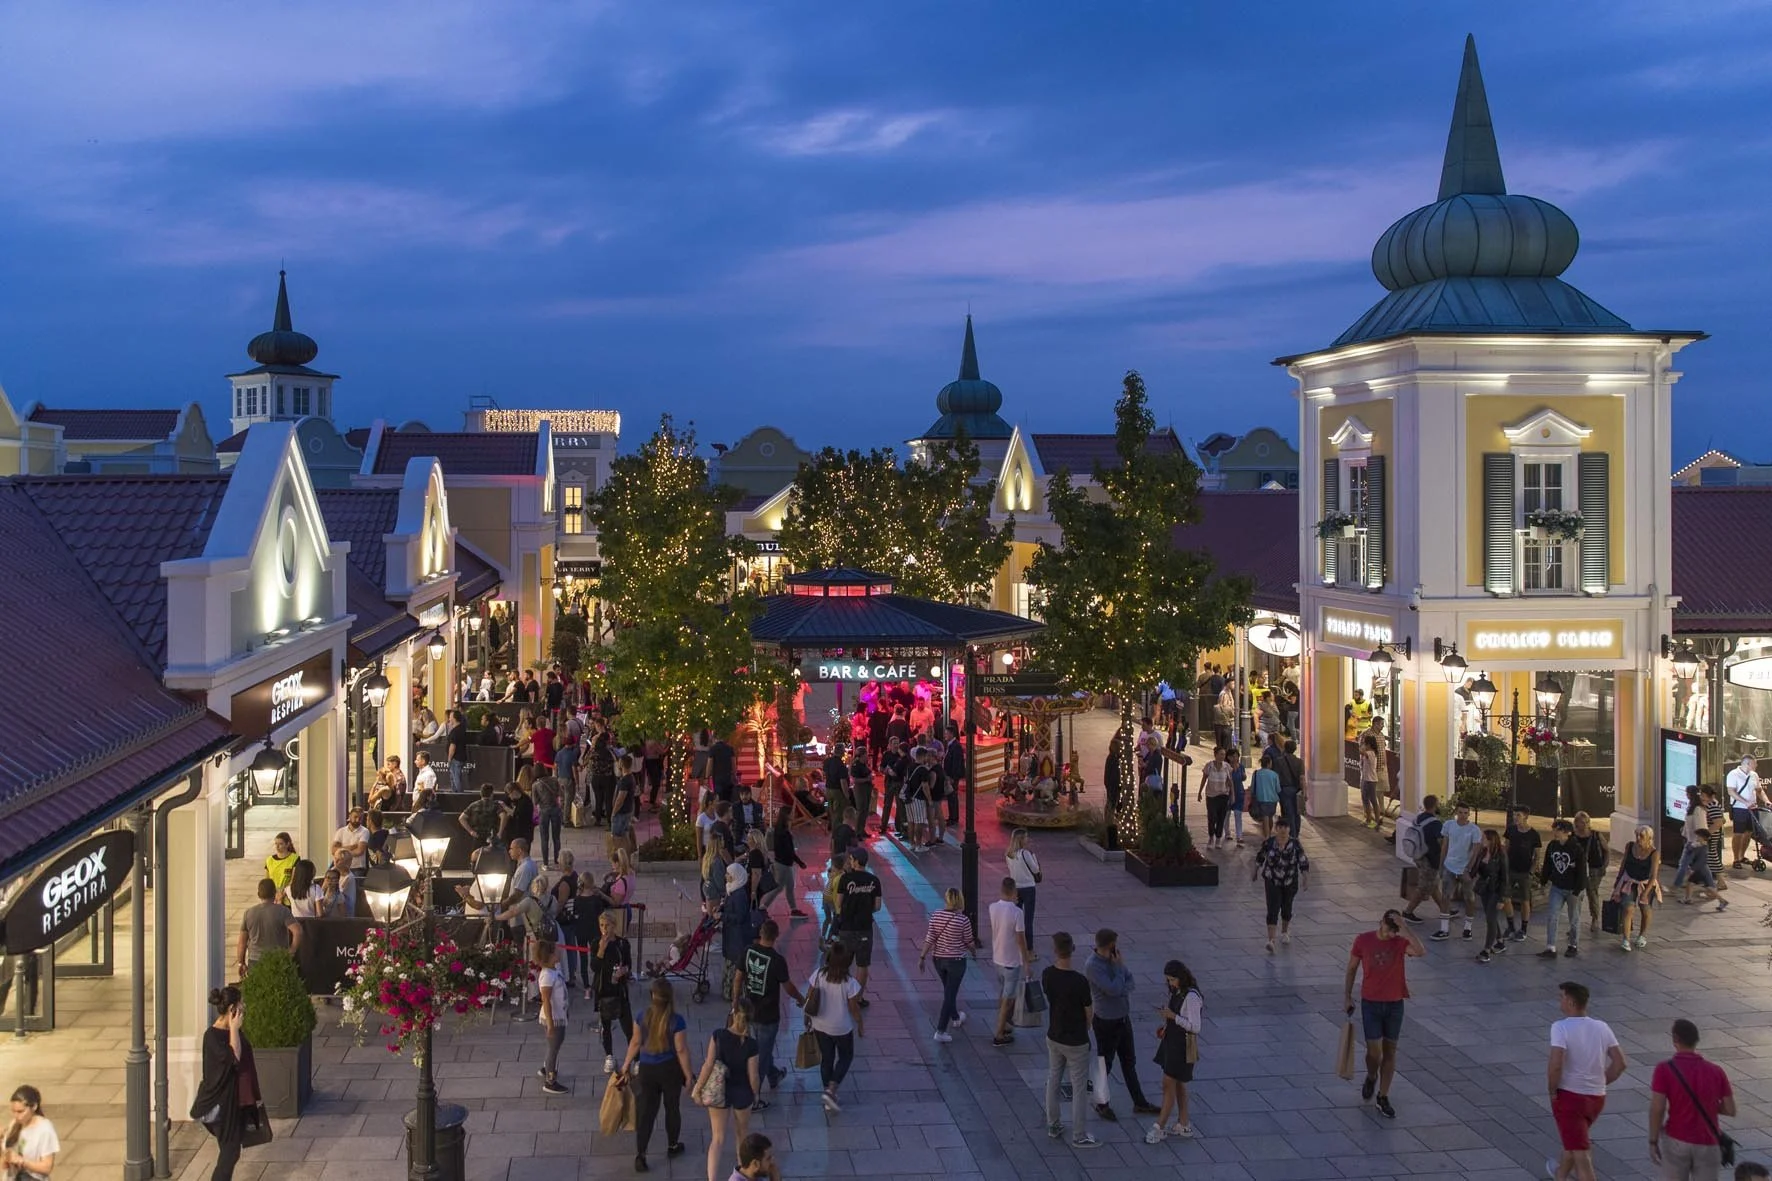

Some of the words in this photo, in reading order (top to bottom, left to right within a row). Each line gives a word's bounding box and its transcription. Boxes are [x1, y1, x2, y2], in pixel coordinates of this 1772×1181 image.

[555, 437, 588, 446] RRY
[819, 665, 852, 679] BAR
[857, 665, 869, 679] &
[874, 661, 916, 678] CAFÉ
[271, 670, 304, 706] GEOX
[983, 686, 1006, 694] BOSS
[271, 695, 304, 725] RESPIRA
[42, 845, 107, 909] GEOX
[42, 874, 107, 935] RESPIRA
